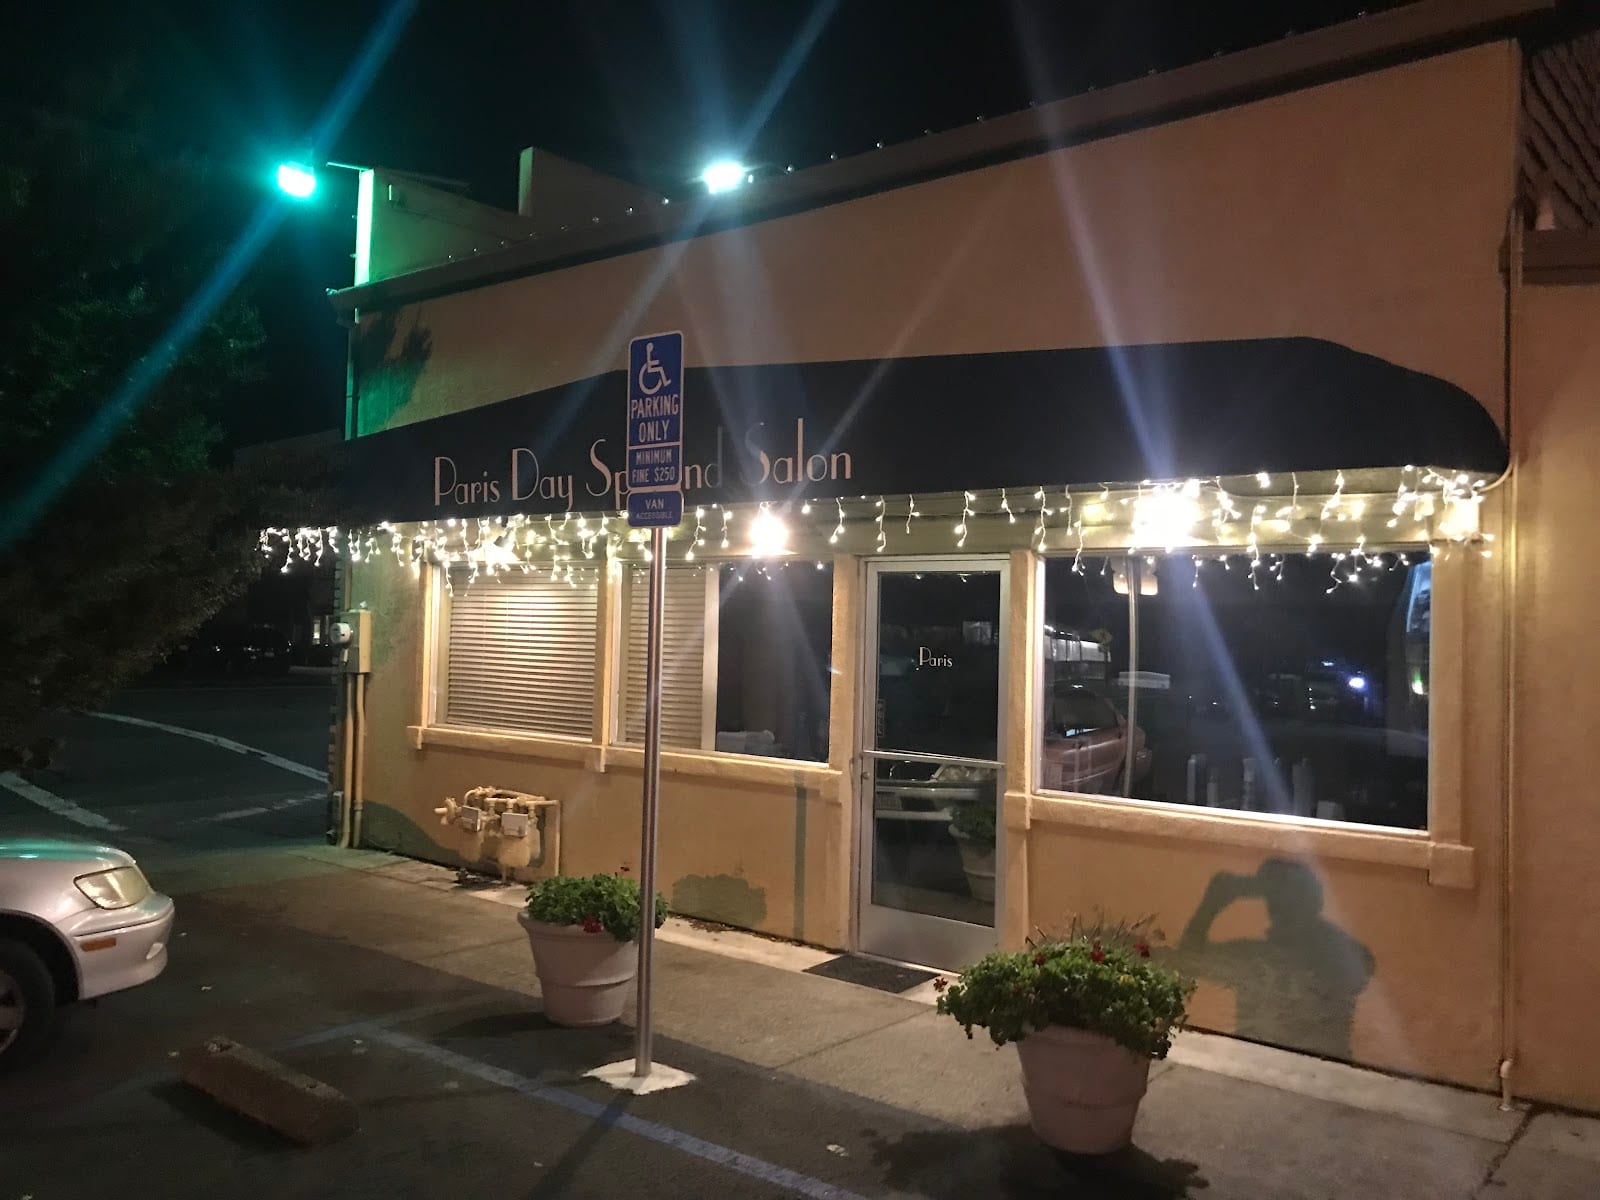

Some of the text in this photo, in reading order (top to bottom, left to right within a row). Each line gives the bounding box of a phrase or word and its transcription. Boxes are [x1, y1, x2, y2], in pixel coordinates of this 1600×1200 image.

[631, 394, 679, 419] PARKING
[638, 419, 670, 443] ONLY
[434, 418, 852, 512] Paris Day Sp nd Salon
[635, 448, 673, 465] MINIMUM
[632, 466, 675, 483] FINE $250
[645, 498, 665, 510] VAN
[919, 646, 953, 667] Paris
